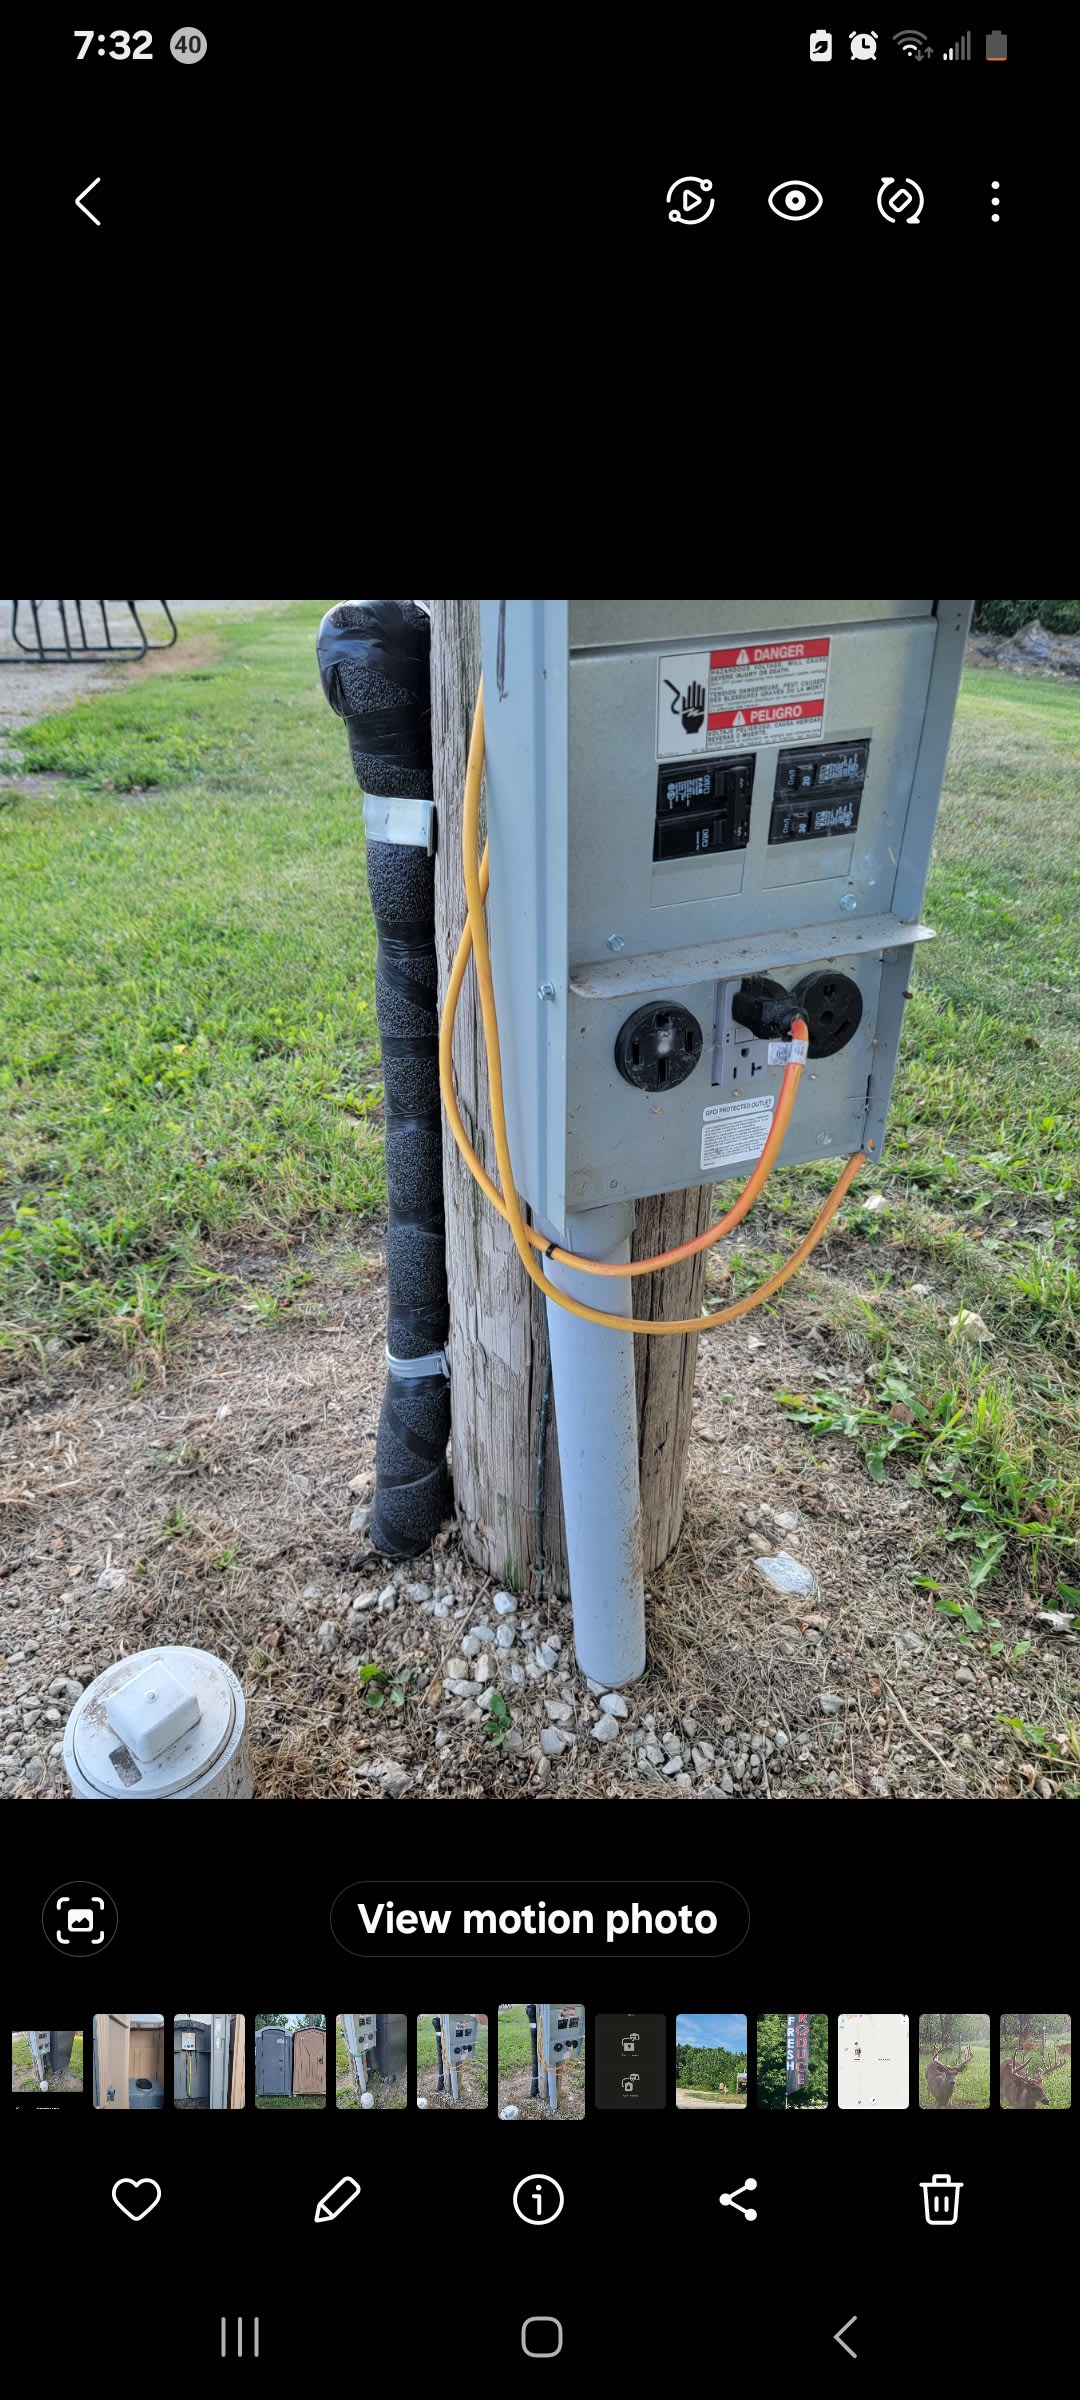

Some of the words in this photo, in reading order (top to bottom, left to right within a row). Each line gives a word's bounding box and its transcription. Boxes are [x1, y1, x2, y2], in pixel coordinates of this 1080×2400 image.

[74, 30, 153, 60] 7:32
[174, 35, 201, 54] 40
[754, 644, 804, 662] DANGER
[711, 665, 750, 675] HAZARDOUS
[711, 673, 733, 682] SEVERE
[735, 670, 757, 679] INJURY
[710, 689, 737, 698] TENSION
[710, 695, 722, 703] DES
[760, 688, 784, 697] GRAVES
[750, 705, 802, 723] PELIGRO
[708, 727, 734, 737] VOLTAJE
[775, 721, 794, 729] CAUSA
[708, 734, 734, 742] SEVERAS
[802, 775, 811, 786] 20
[705, 1108, 719, 1117] GFCI
[720, 1102, 751, 1113] PROTECTED
[751, 1099, 772, 1108] OUTLET
[357, 1900, 452, 1935] View
[463, 1900, 594, 1935] motion
[606, 1902, 718, 1943] photo
[787, 2016, 795, 2071] FRESH
